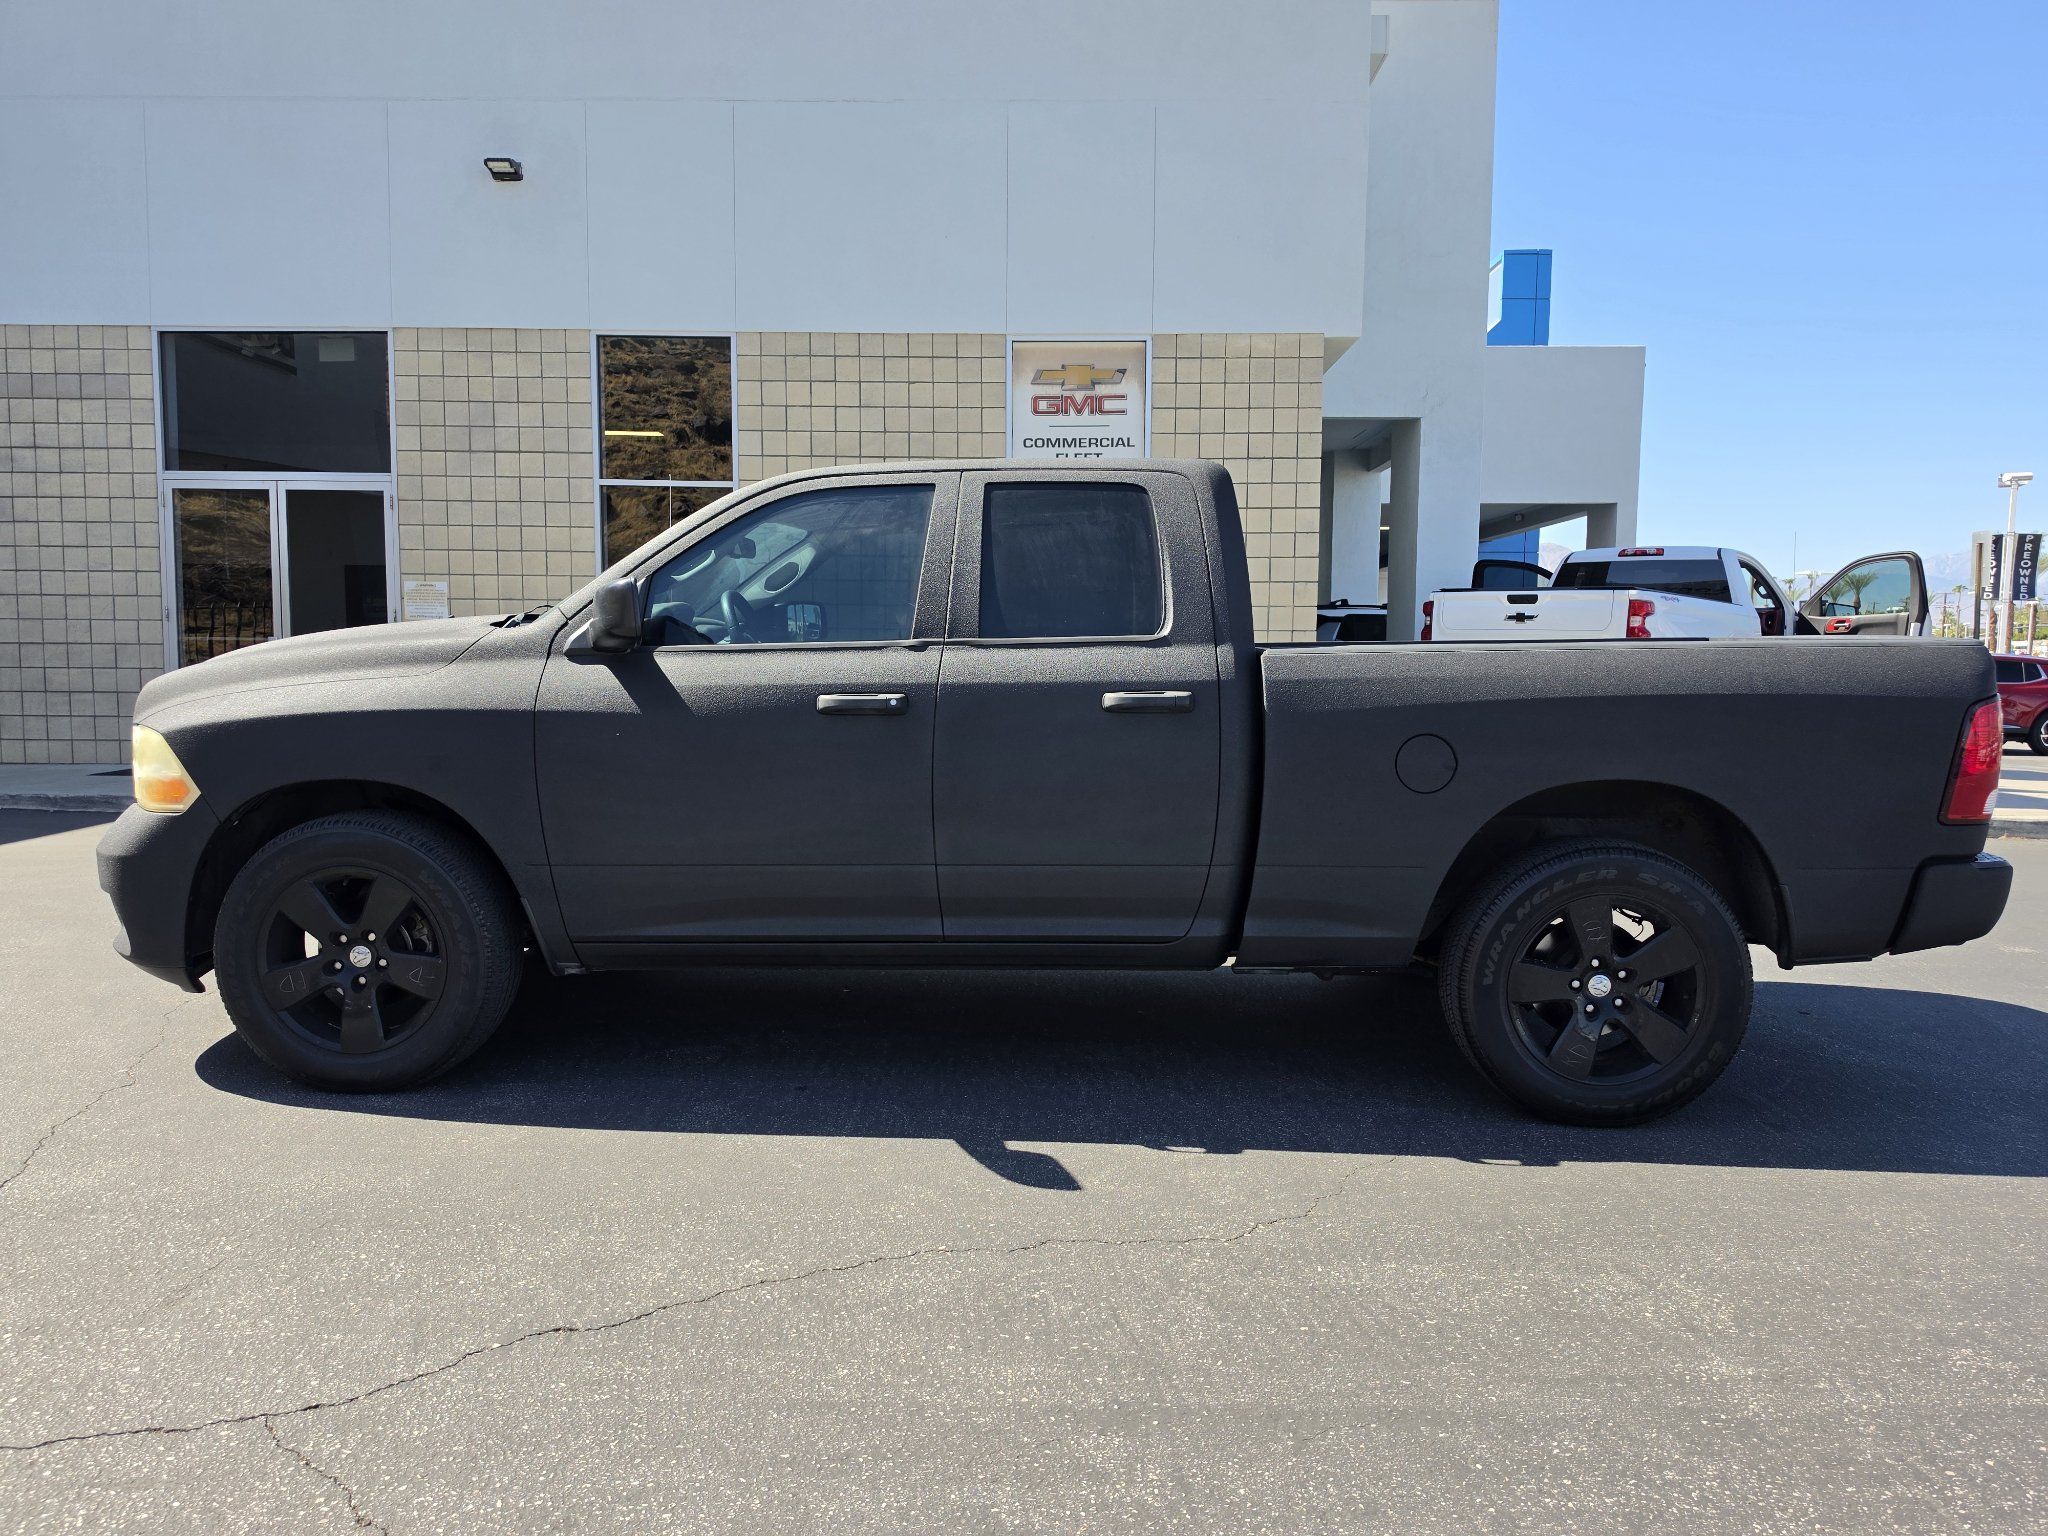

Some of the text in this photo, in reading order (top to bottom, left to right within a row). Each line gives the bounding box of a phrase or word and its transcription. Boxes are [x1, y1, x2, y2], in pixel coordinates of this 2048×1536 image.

[1031, 393, 1127, 416] GMC
[1023, 437, 1135, 449] COMMERCIAL
[2018, 534, 2034, 600] PREOWNED
[1482, 867, 1619, 986] WRANGLER
